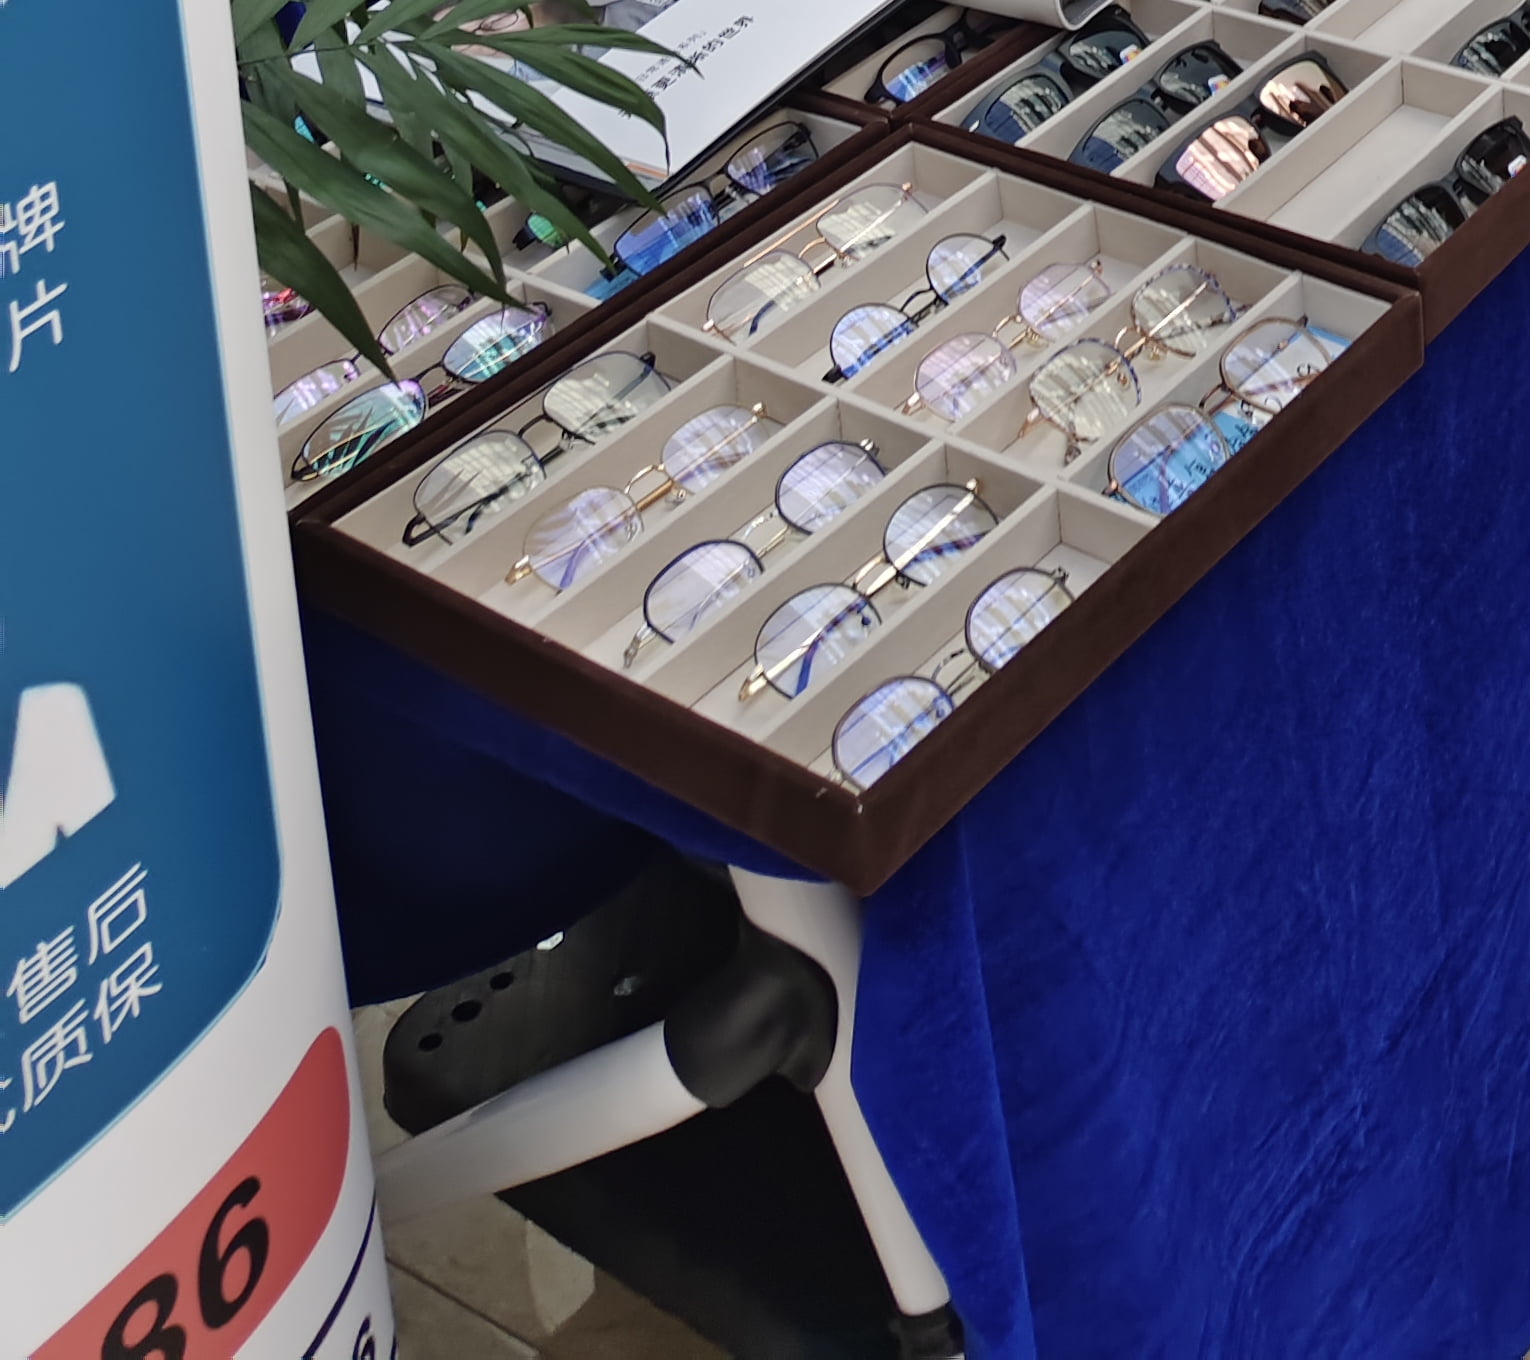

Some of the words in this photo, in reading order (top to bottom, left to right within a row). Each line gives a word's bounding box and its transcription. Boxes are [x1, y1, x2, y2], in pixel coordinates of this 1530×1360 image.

[9, 279, 68, 373] 片
[6, 861, 149, 1024] 售后
[0, 941, 163, 1135] 质保
